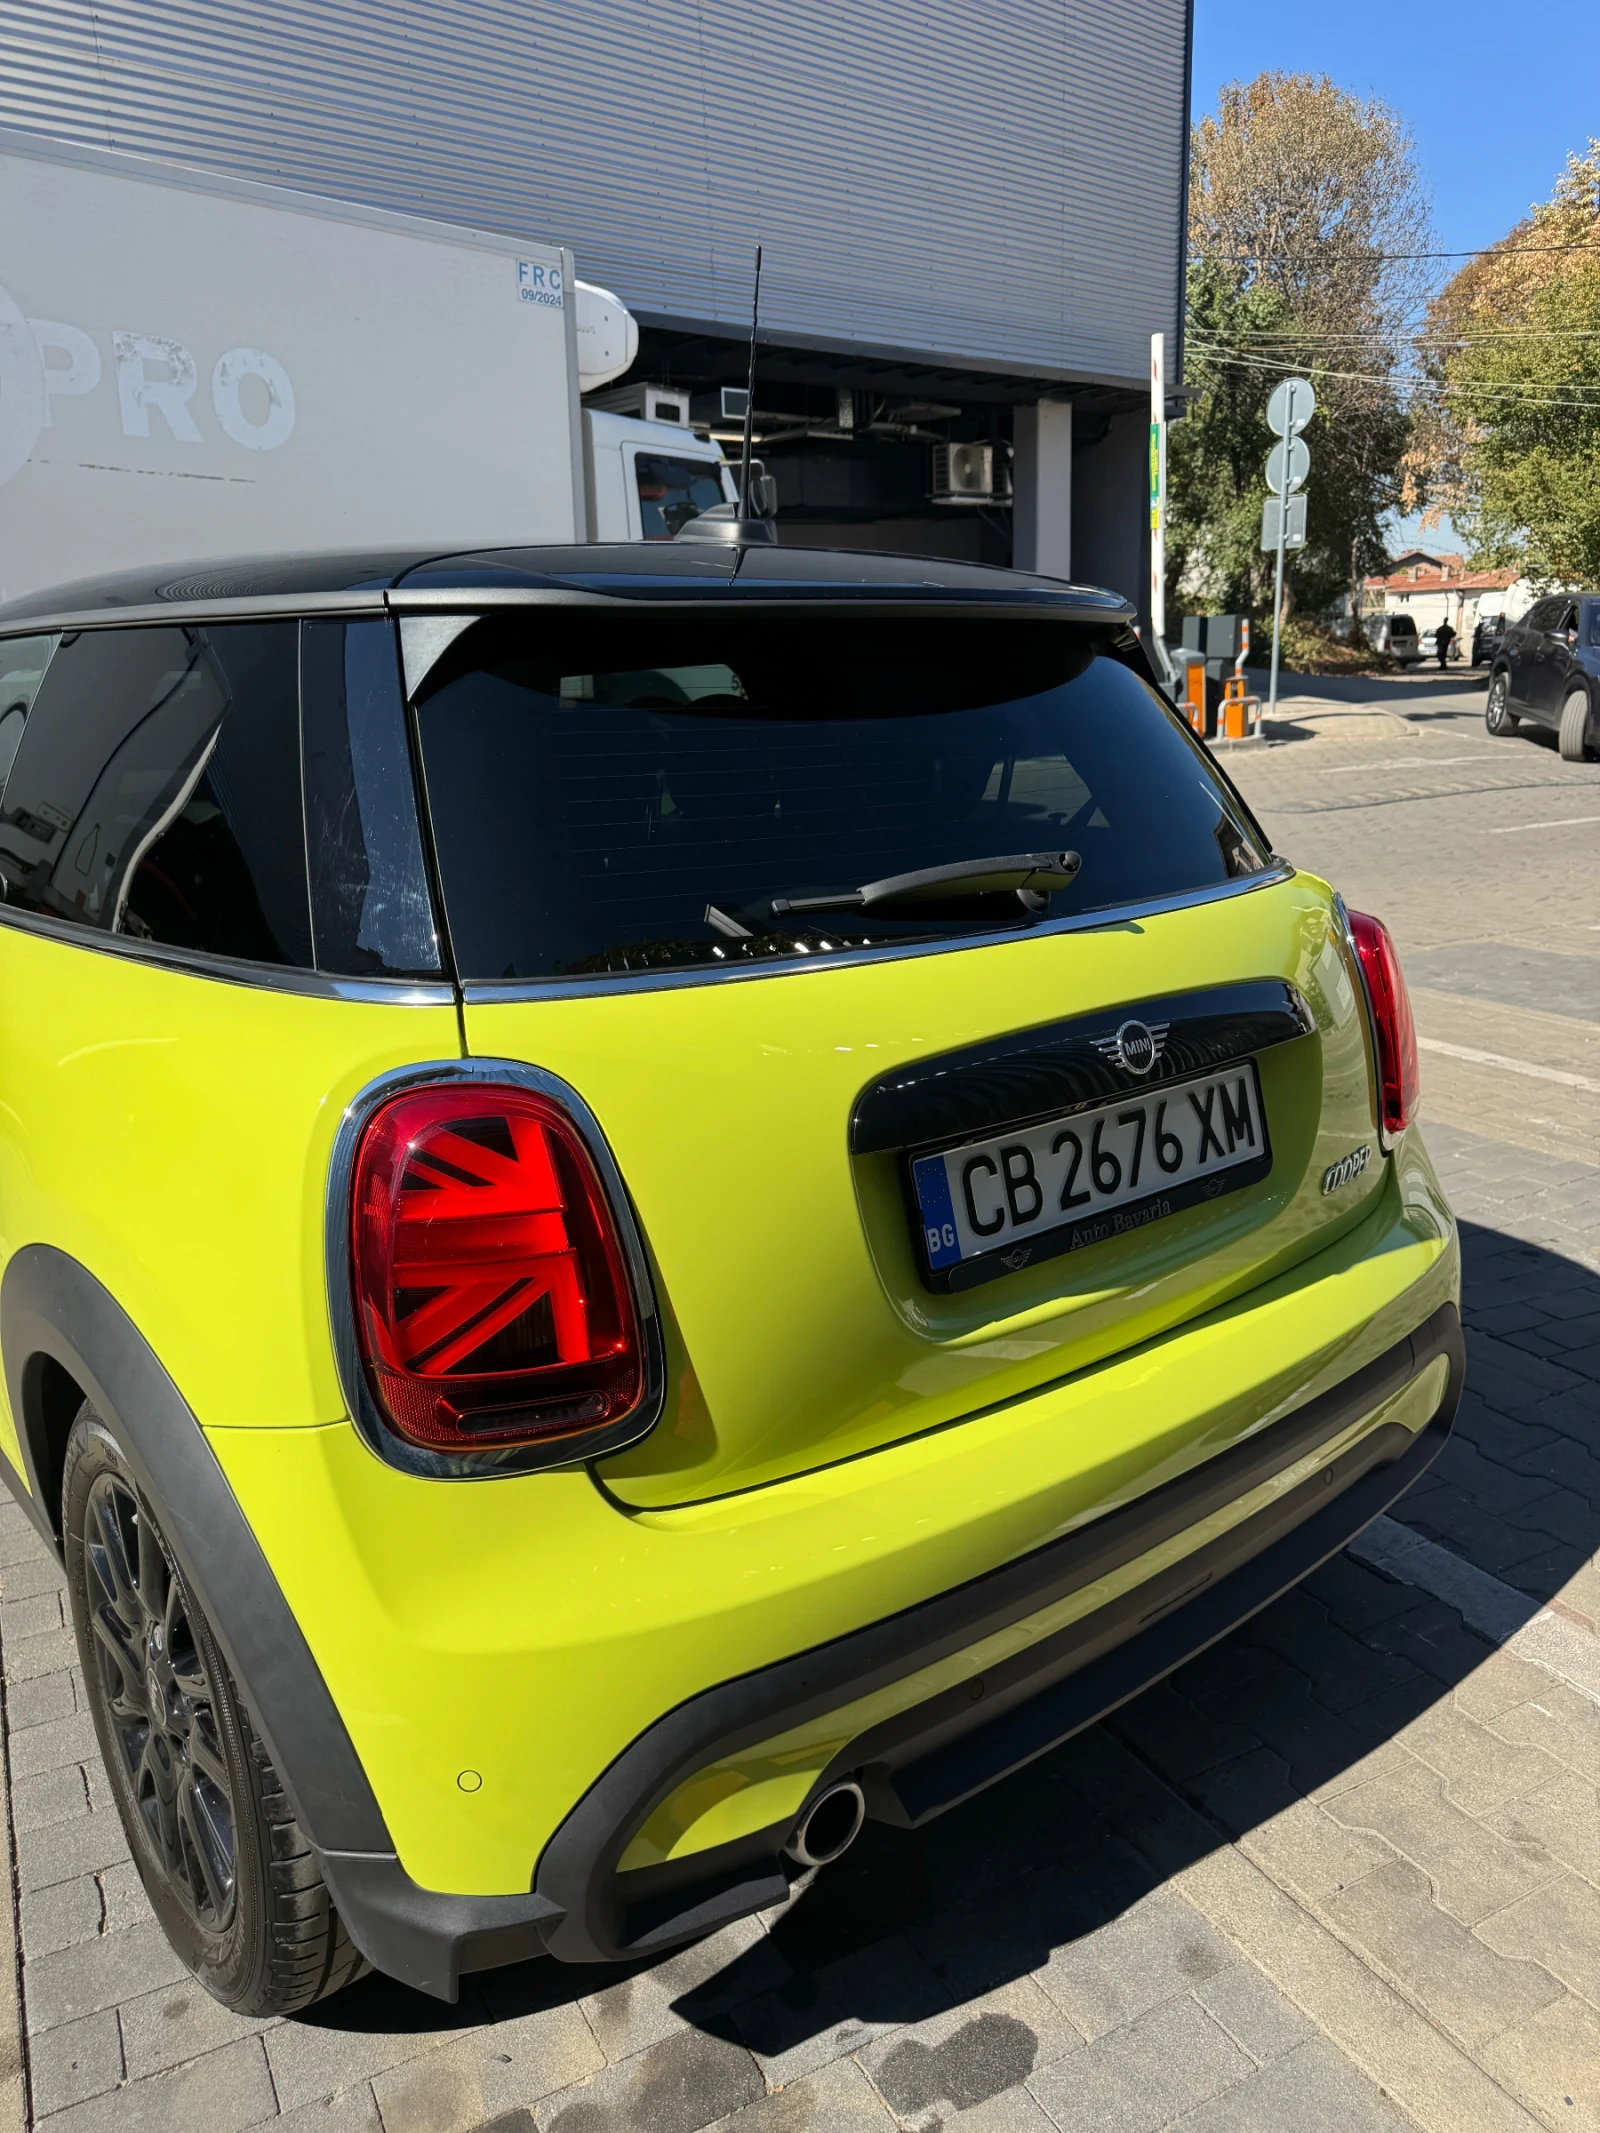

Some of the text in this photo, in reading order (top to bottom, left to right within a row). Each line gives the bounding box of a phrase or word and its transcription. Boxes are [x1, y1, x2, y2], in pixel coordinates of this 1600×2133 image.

[519, 262, 561, 290] FRC
[522, 288, 562, 306] 09/2024
[1124, 1037, 1151, 1056] MINI
[963, 1078, 1256, 1237] CB 2676 XM
[1322, 1144, 1372, 1196] COOPER
[927, 1224, 955, 1253] BG
[1070, 1198, 1172, 1250] Auto Bavaria
